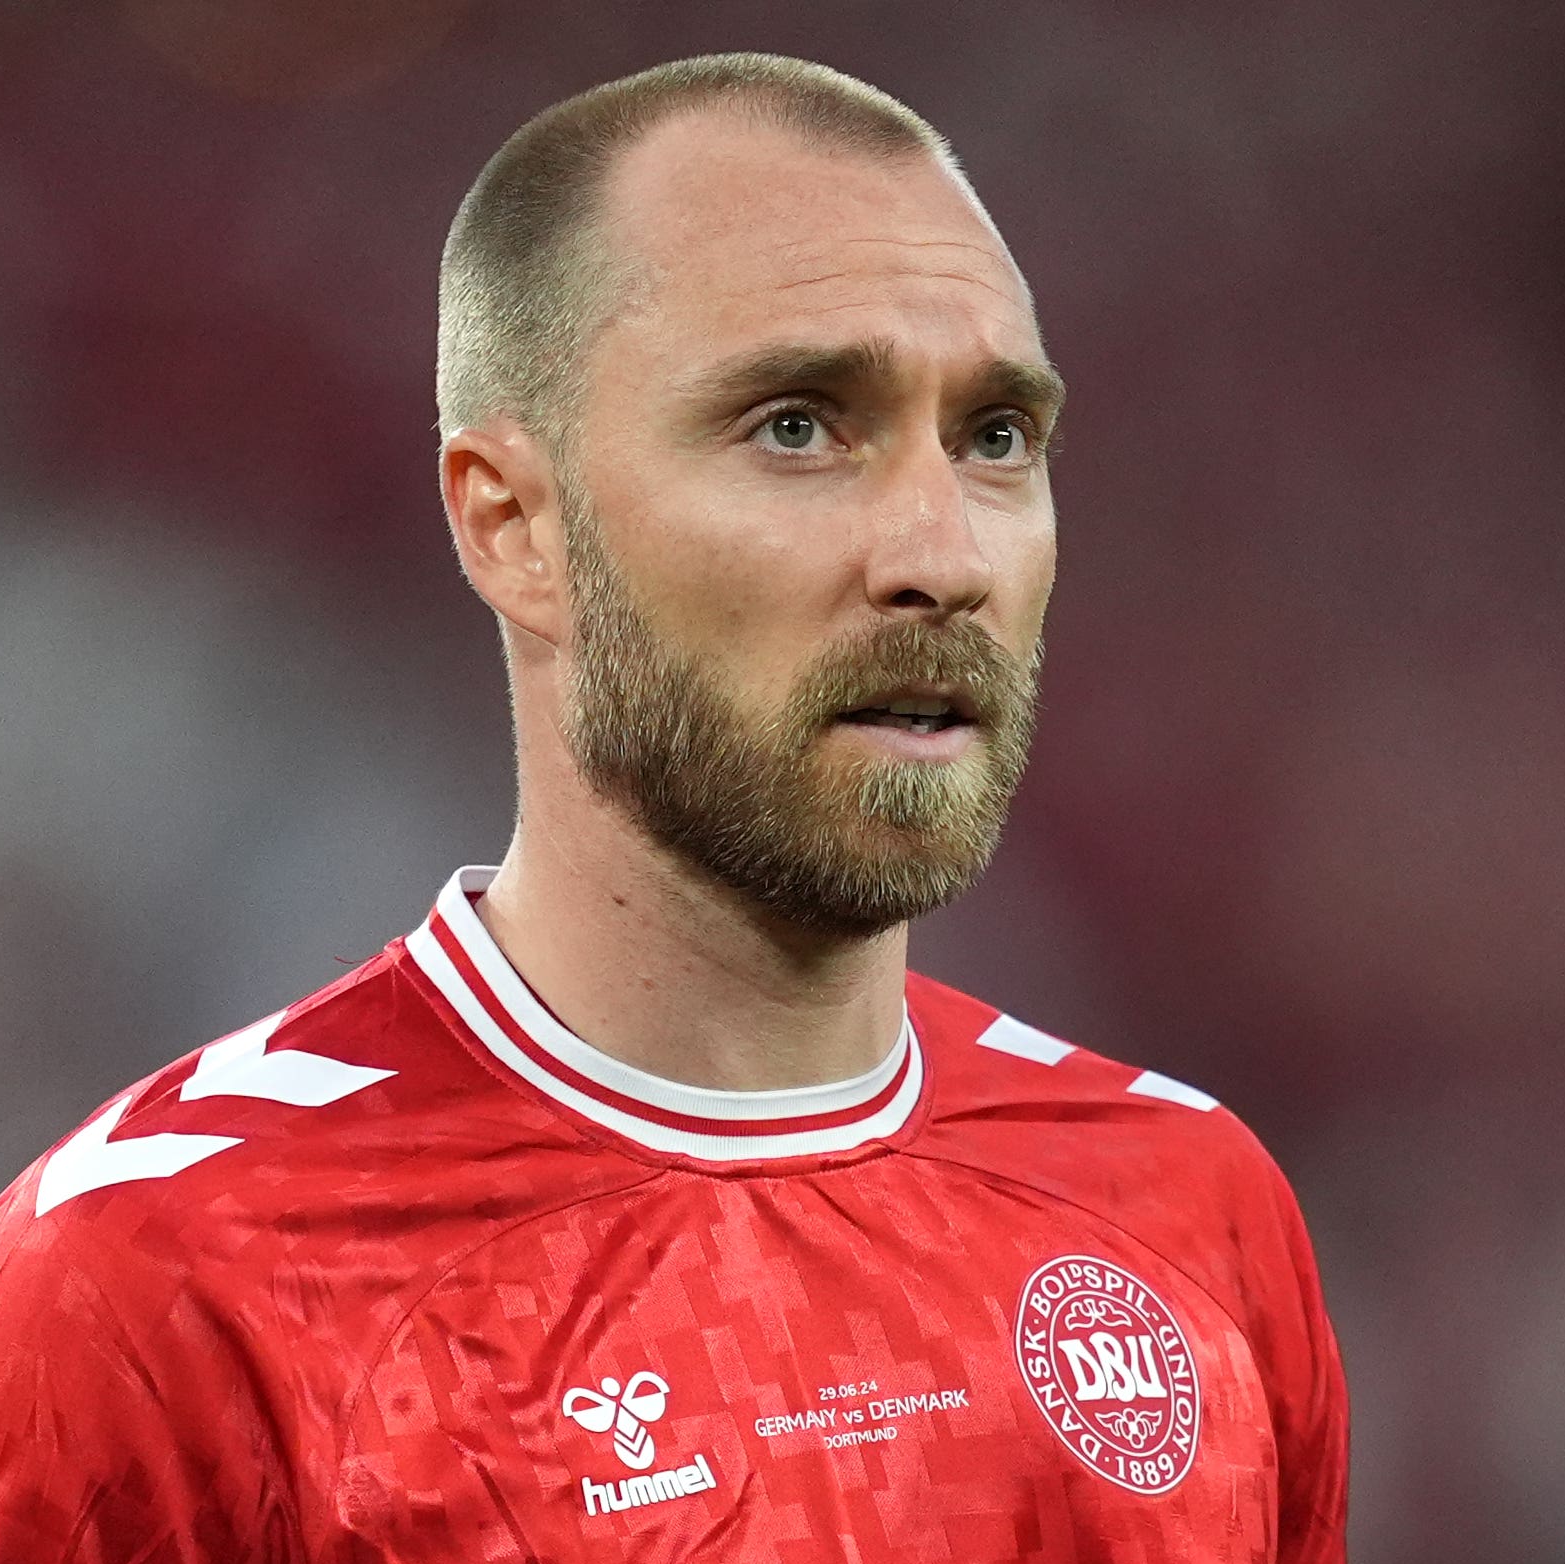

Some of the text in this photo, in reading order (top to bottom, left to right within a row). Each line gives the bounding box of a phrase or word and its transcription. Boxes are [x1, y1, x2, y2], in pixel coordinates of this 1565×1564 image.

[818, 1380, 878, 1402] 29.06.24
[1057, 1331, 1167, 1402] DBU
[754, 1388, 970, 1438] GERMANY vs DENMARK
[1024, 1325, 1103, 1462] DANSK
[823, 1425, 898, 1450] DORTMUND
[581, 1454, 717, 1517] hummel
[1115, 1452, 1175, 1486] 1889
